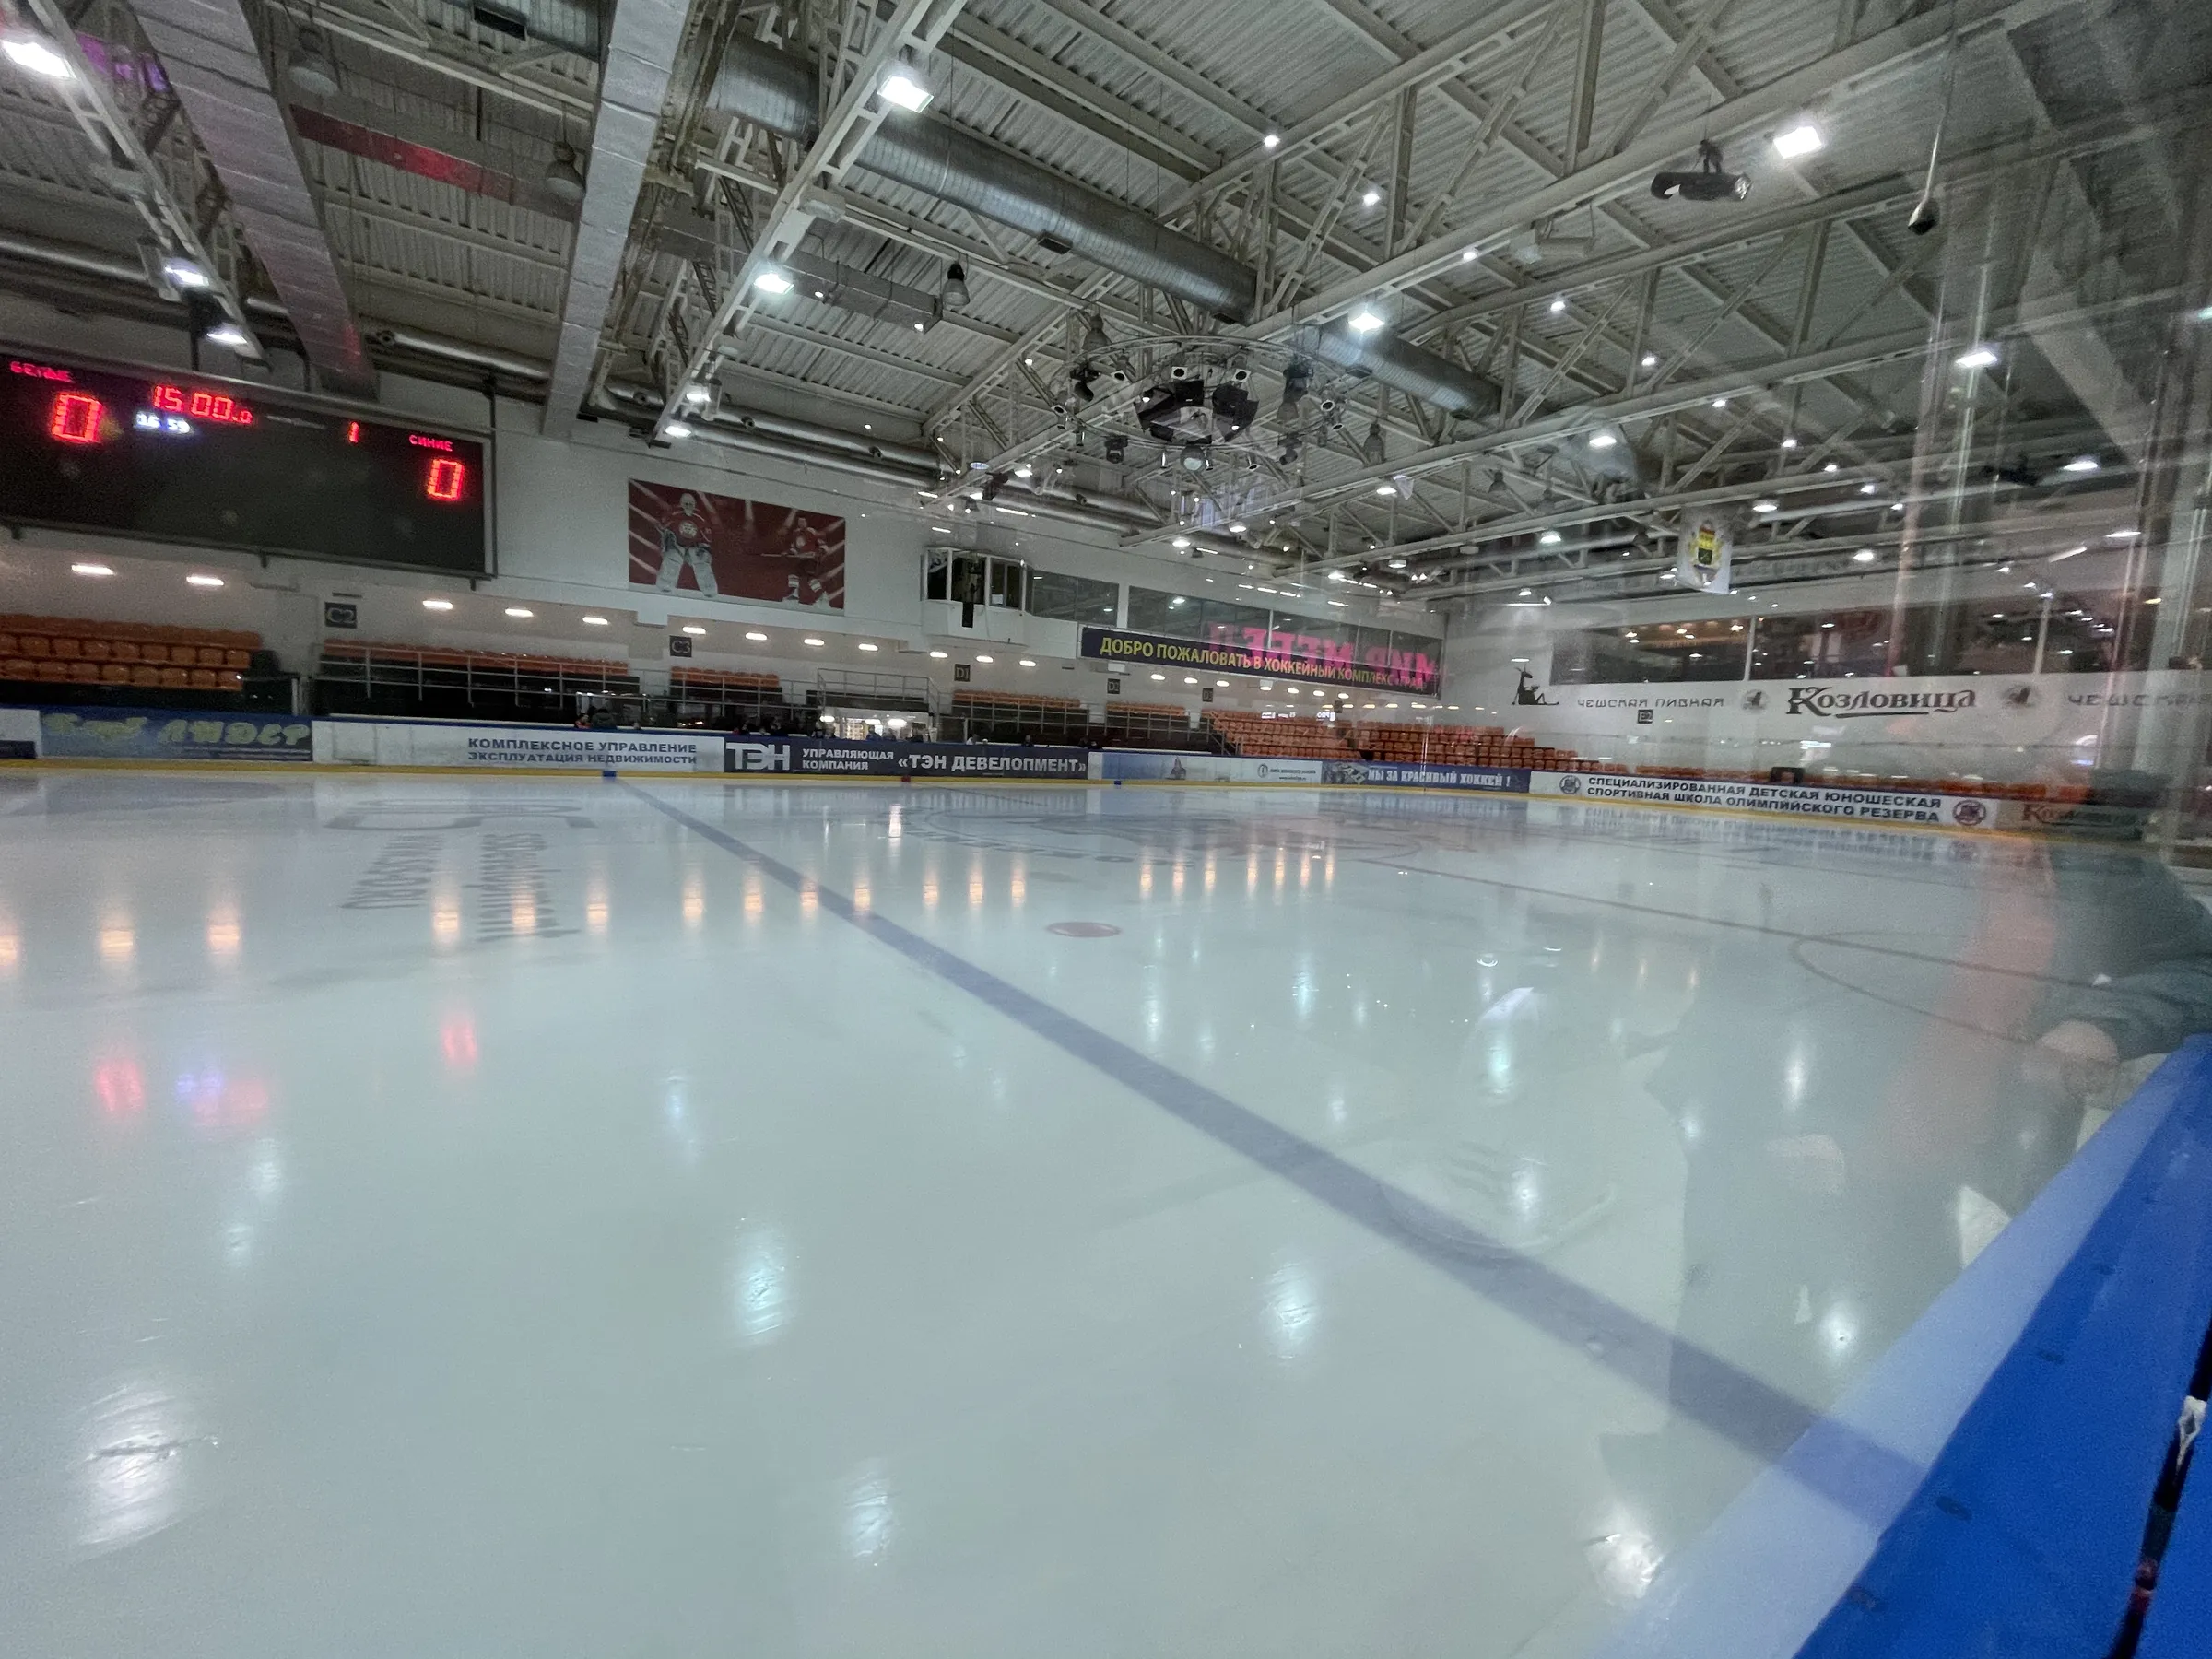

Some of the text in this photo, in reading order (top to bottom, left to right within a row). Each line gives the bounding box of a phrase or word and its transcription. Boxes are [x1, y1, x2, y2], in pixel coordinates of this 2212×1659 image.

[52, 393, 100, 442] 0
[348, 421, 359, 443] 1
[408, 434, 453, 452] СИНИЕ
[427, 458, 465, 499] 0
[327, 606, 356, 624] C2
[671, 641, 691, 653] C3
[1100, 636, 1153, 657] ДОБРО
[1156, 644, 1252, 669] ПОЖАЛОВАТЬ
[1253, 656, 1263, 669] В
[1264, 657, 1336, 680] ХОККЕЙНЫЙ
[1336, 667, 1394, 686] КОМПЛЕКС
[1577, 698, 1724, 708] ЧЕШСКАЯ ПИВНАЯ
[468, 738, 697, 753] КОМПЛЕКСНОЕ УПРАВЛЕНИЕ
[802, 748, 894, 760] УПРАВЛЯЮЩАЯ
[467, 752, 697, 764] ЭКСПЛУАТАЦИЯ НЕДВИЖИМОСТИ
[725, 742, 791, 771] ТЭН
[802, 759, 869, 771] КОМПАНИЯ
[898, 754, 1087, 772] «ТЭН ДЕВЕЛОПМЕНТ»
[1368, 769, 1383, 781] МЫ
[1386, 770, 1398, 782] ЗА
[1401, 771, 1457, 783] КРАСИВЫЙ
[1460, 773, 1503, 786] ХОККЕЙ
[1588, 777, 1941, 808] СПЕЦИАЛИЗИРОВАННАЯ ДЕТСКАЯ ЮНОШЕСКАЯ
[1587, 787, 1940, 822] СПОРТИВНАЯ ШКОЛА ОЛИМПИЙСКОГО РЕЗЕРВА
